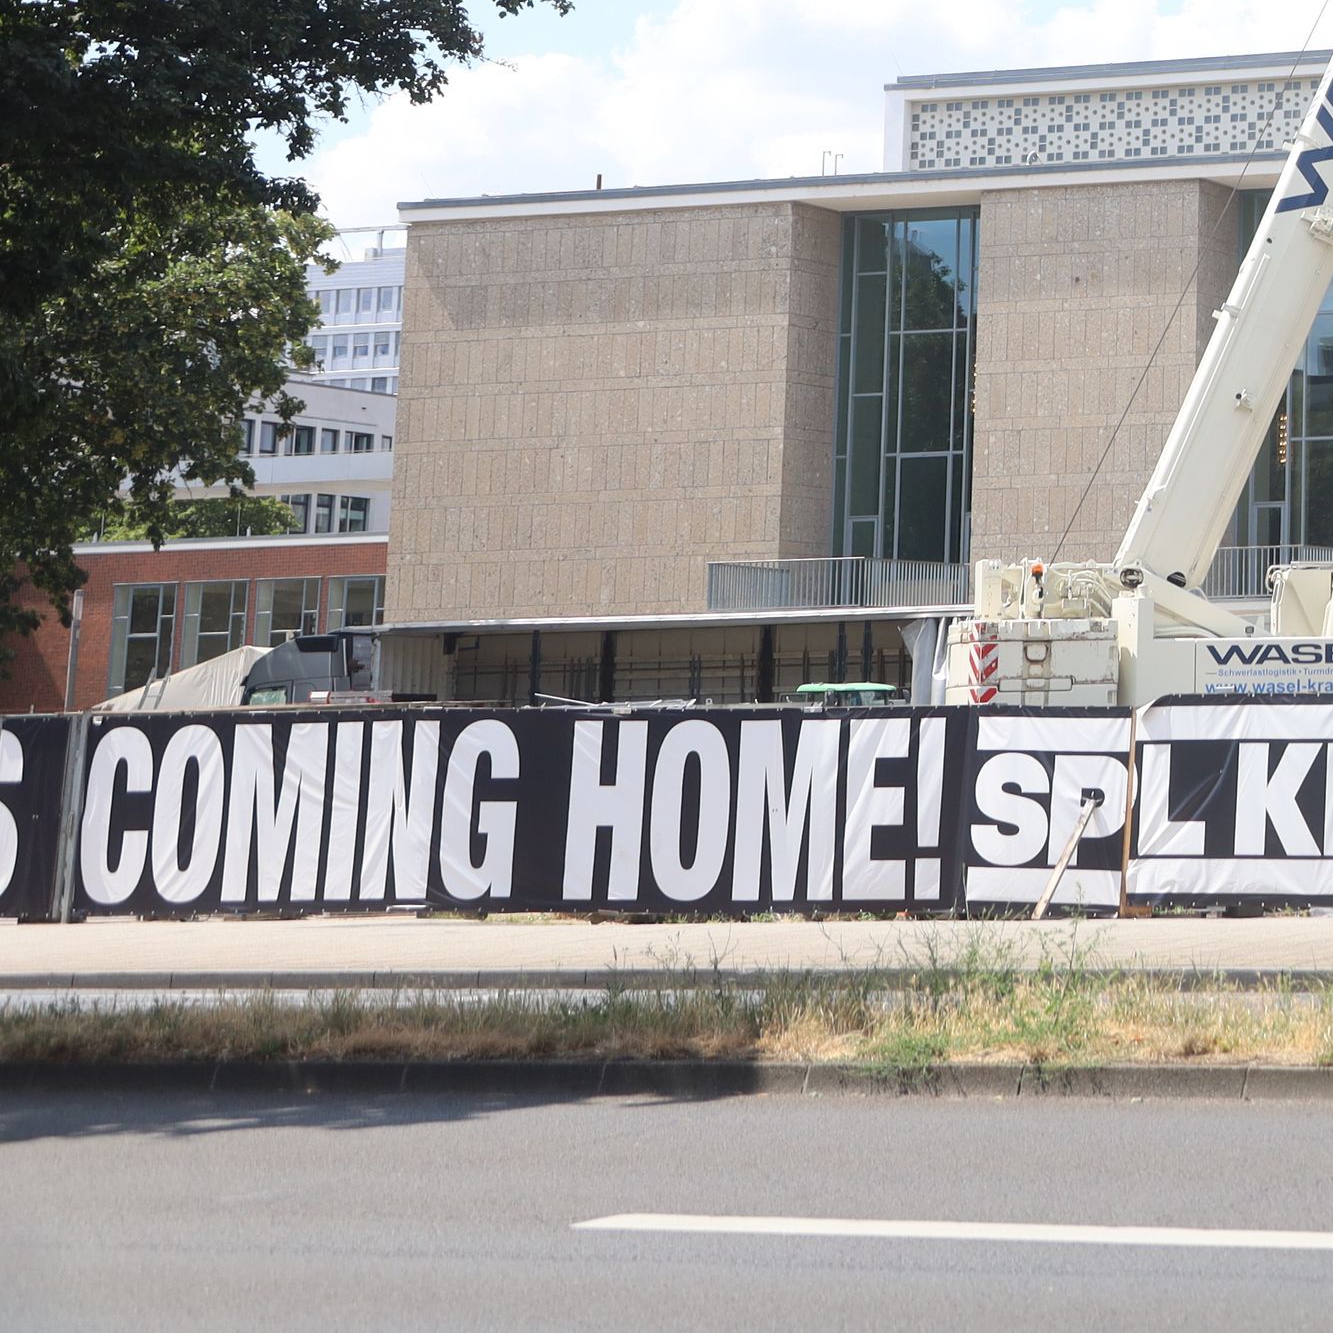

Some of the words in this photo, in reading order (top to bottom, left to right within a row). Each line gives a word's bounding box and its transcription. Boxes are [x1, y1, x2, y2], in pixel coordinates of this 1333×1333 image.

[1217, 668, 1297, 678] Schwerlastlogistik
[80, 719, 521, 905] COMING
[562, 717, 948, 903] HOME!
